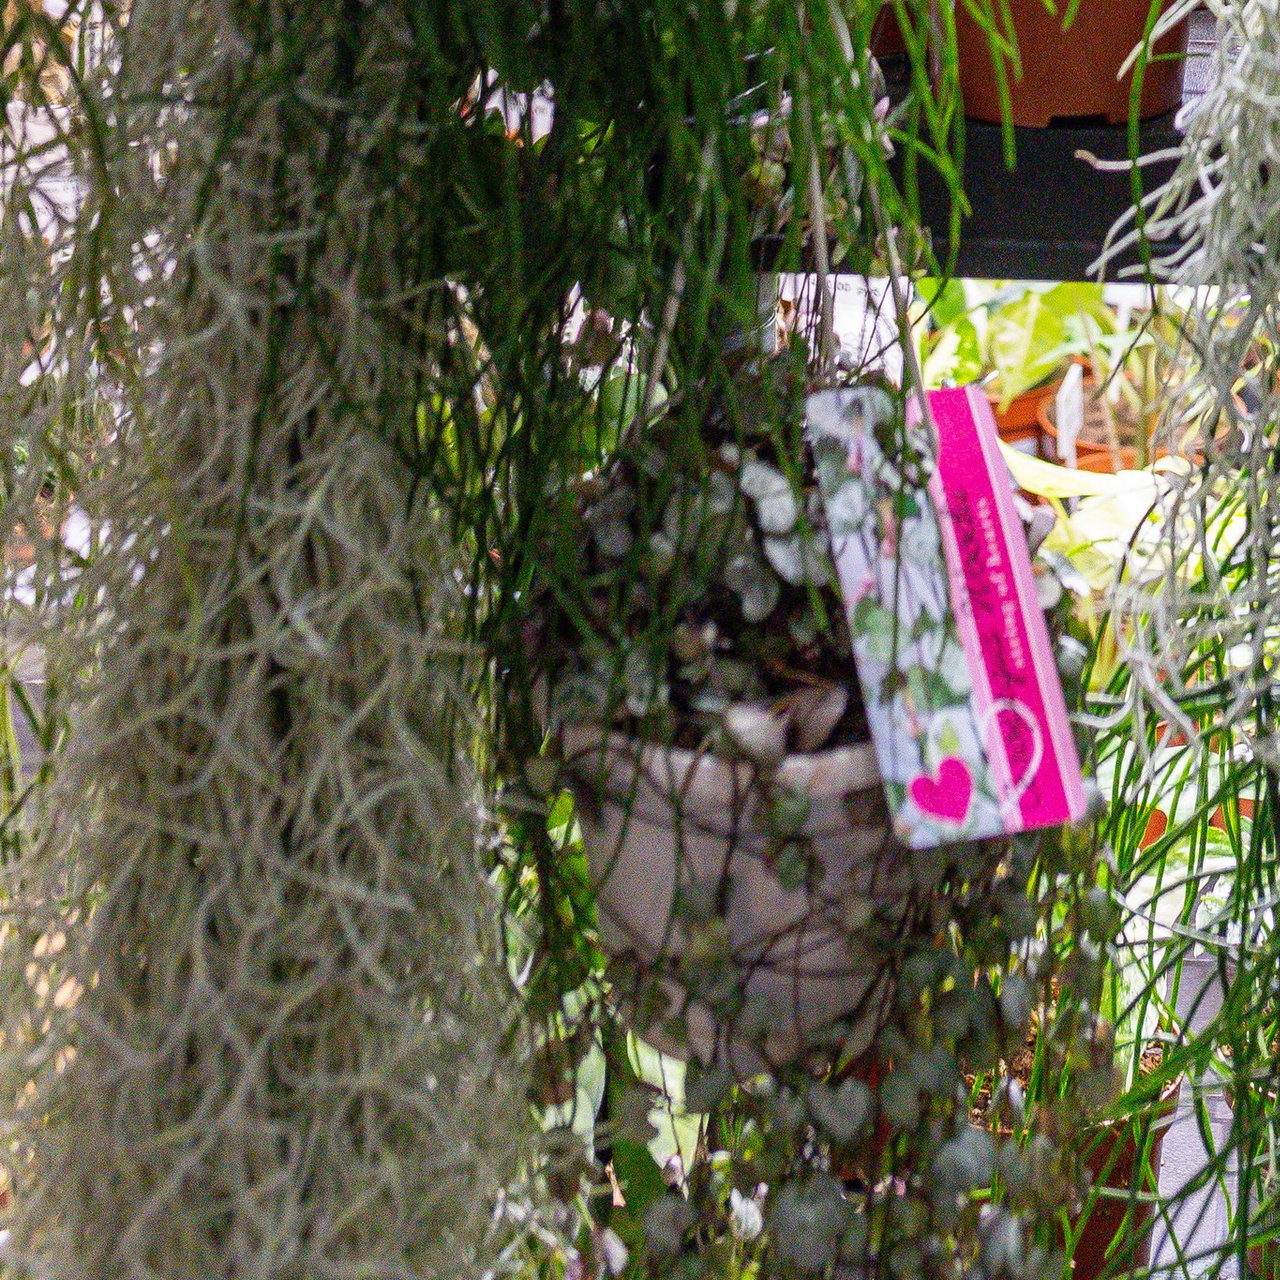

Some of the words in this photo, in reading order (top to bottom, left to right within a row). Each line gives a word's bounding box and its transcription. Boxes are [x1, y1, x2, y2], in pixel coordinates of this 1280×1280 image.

[977, 497, 1003, 568] hearts
[987, 569, 1009, 595] of
[1000, 600, 1025, 669] string
